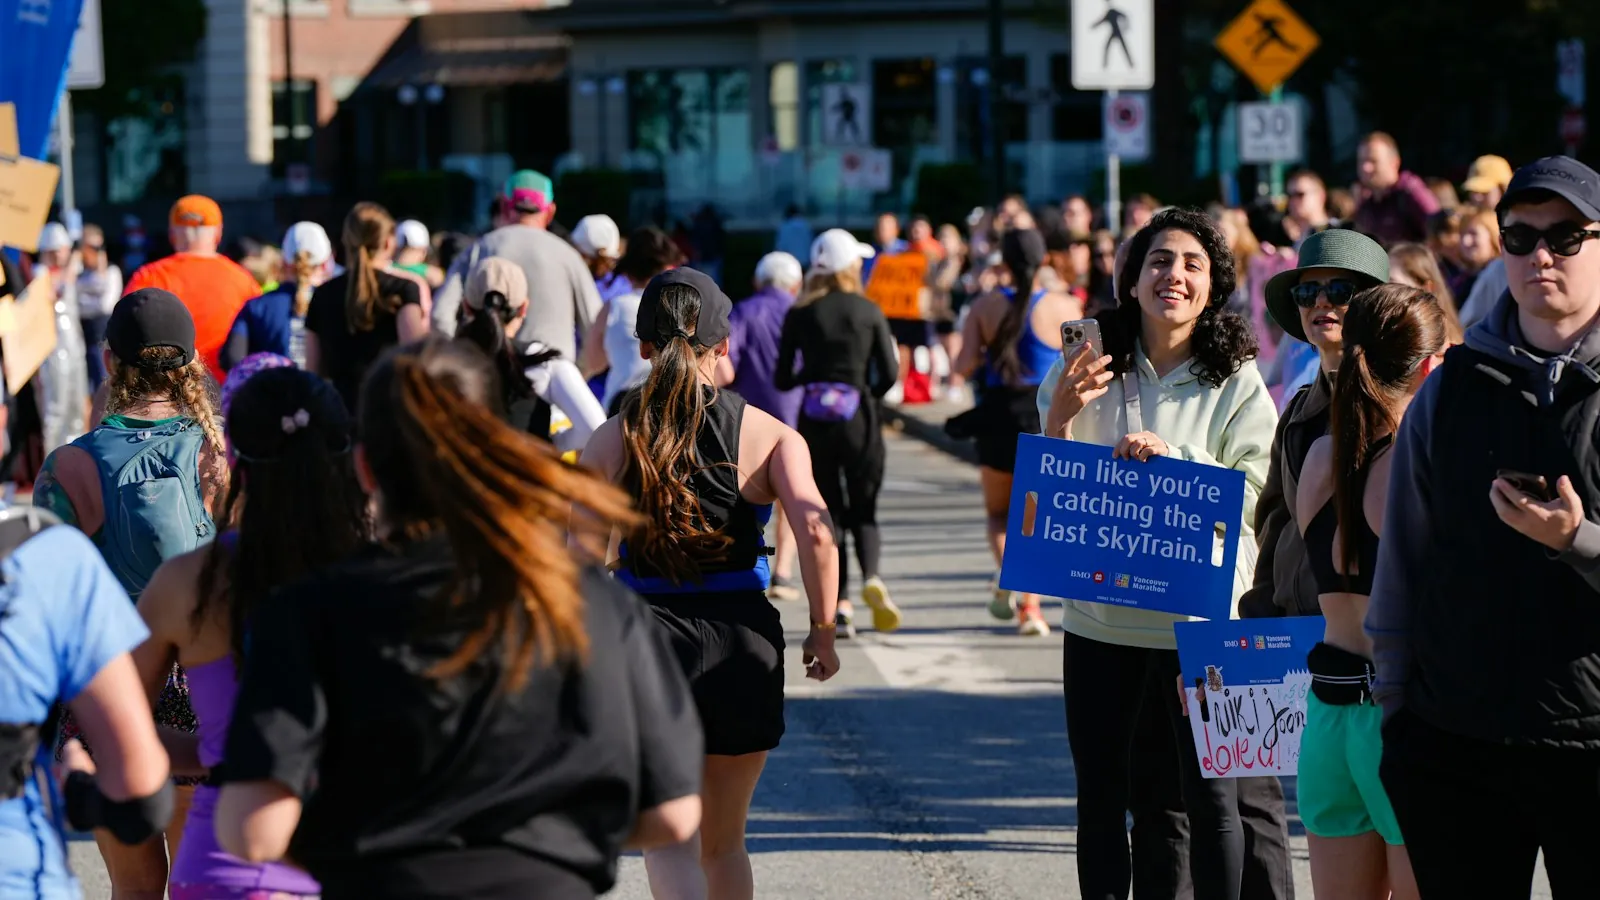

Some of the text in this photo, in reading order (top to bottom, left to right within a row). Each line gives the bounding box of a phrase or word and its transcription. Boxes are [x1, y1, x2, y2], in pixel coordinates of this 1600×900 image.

[1250, 109, 1293, 139] 30
[1040, 453, 1221, 504] Run like you're
[1052, 491, 1203, 531] catching the
[1044, 516, 1203, 564] last SkyTrain.
[1070, 570, 1091, 579] BMO
[1132, 583, 1166, 593] Marathon
[1133, 576, 1169, 587] Vancouver
